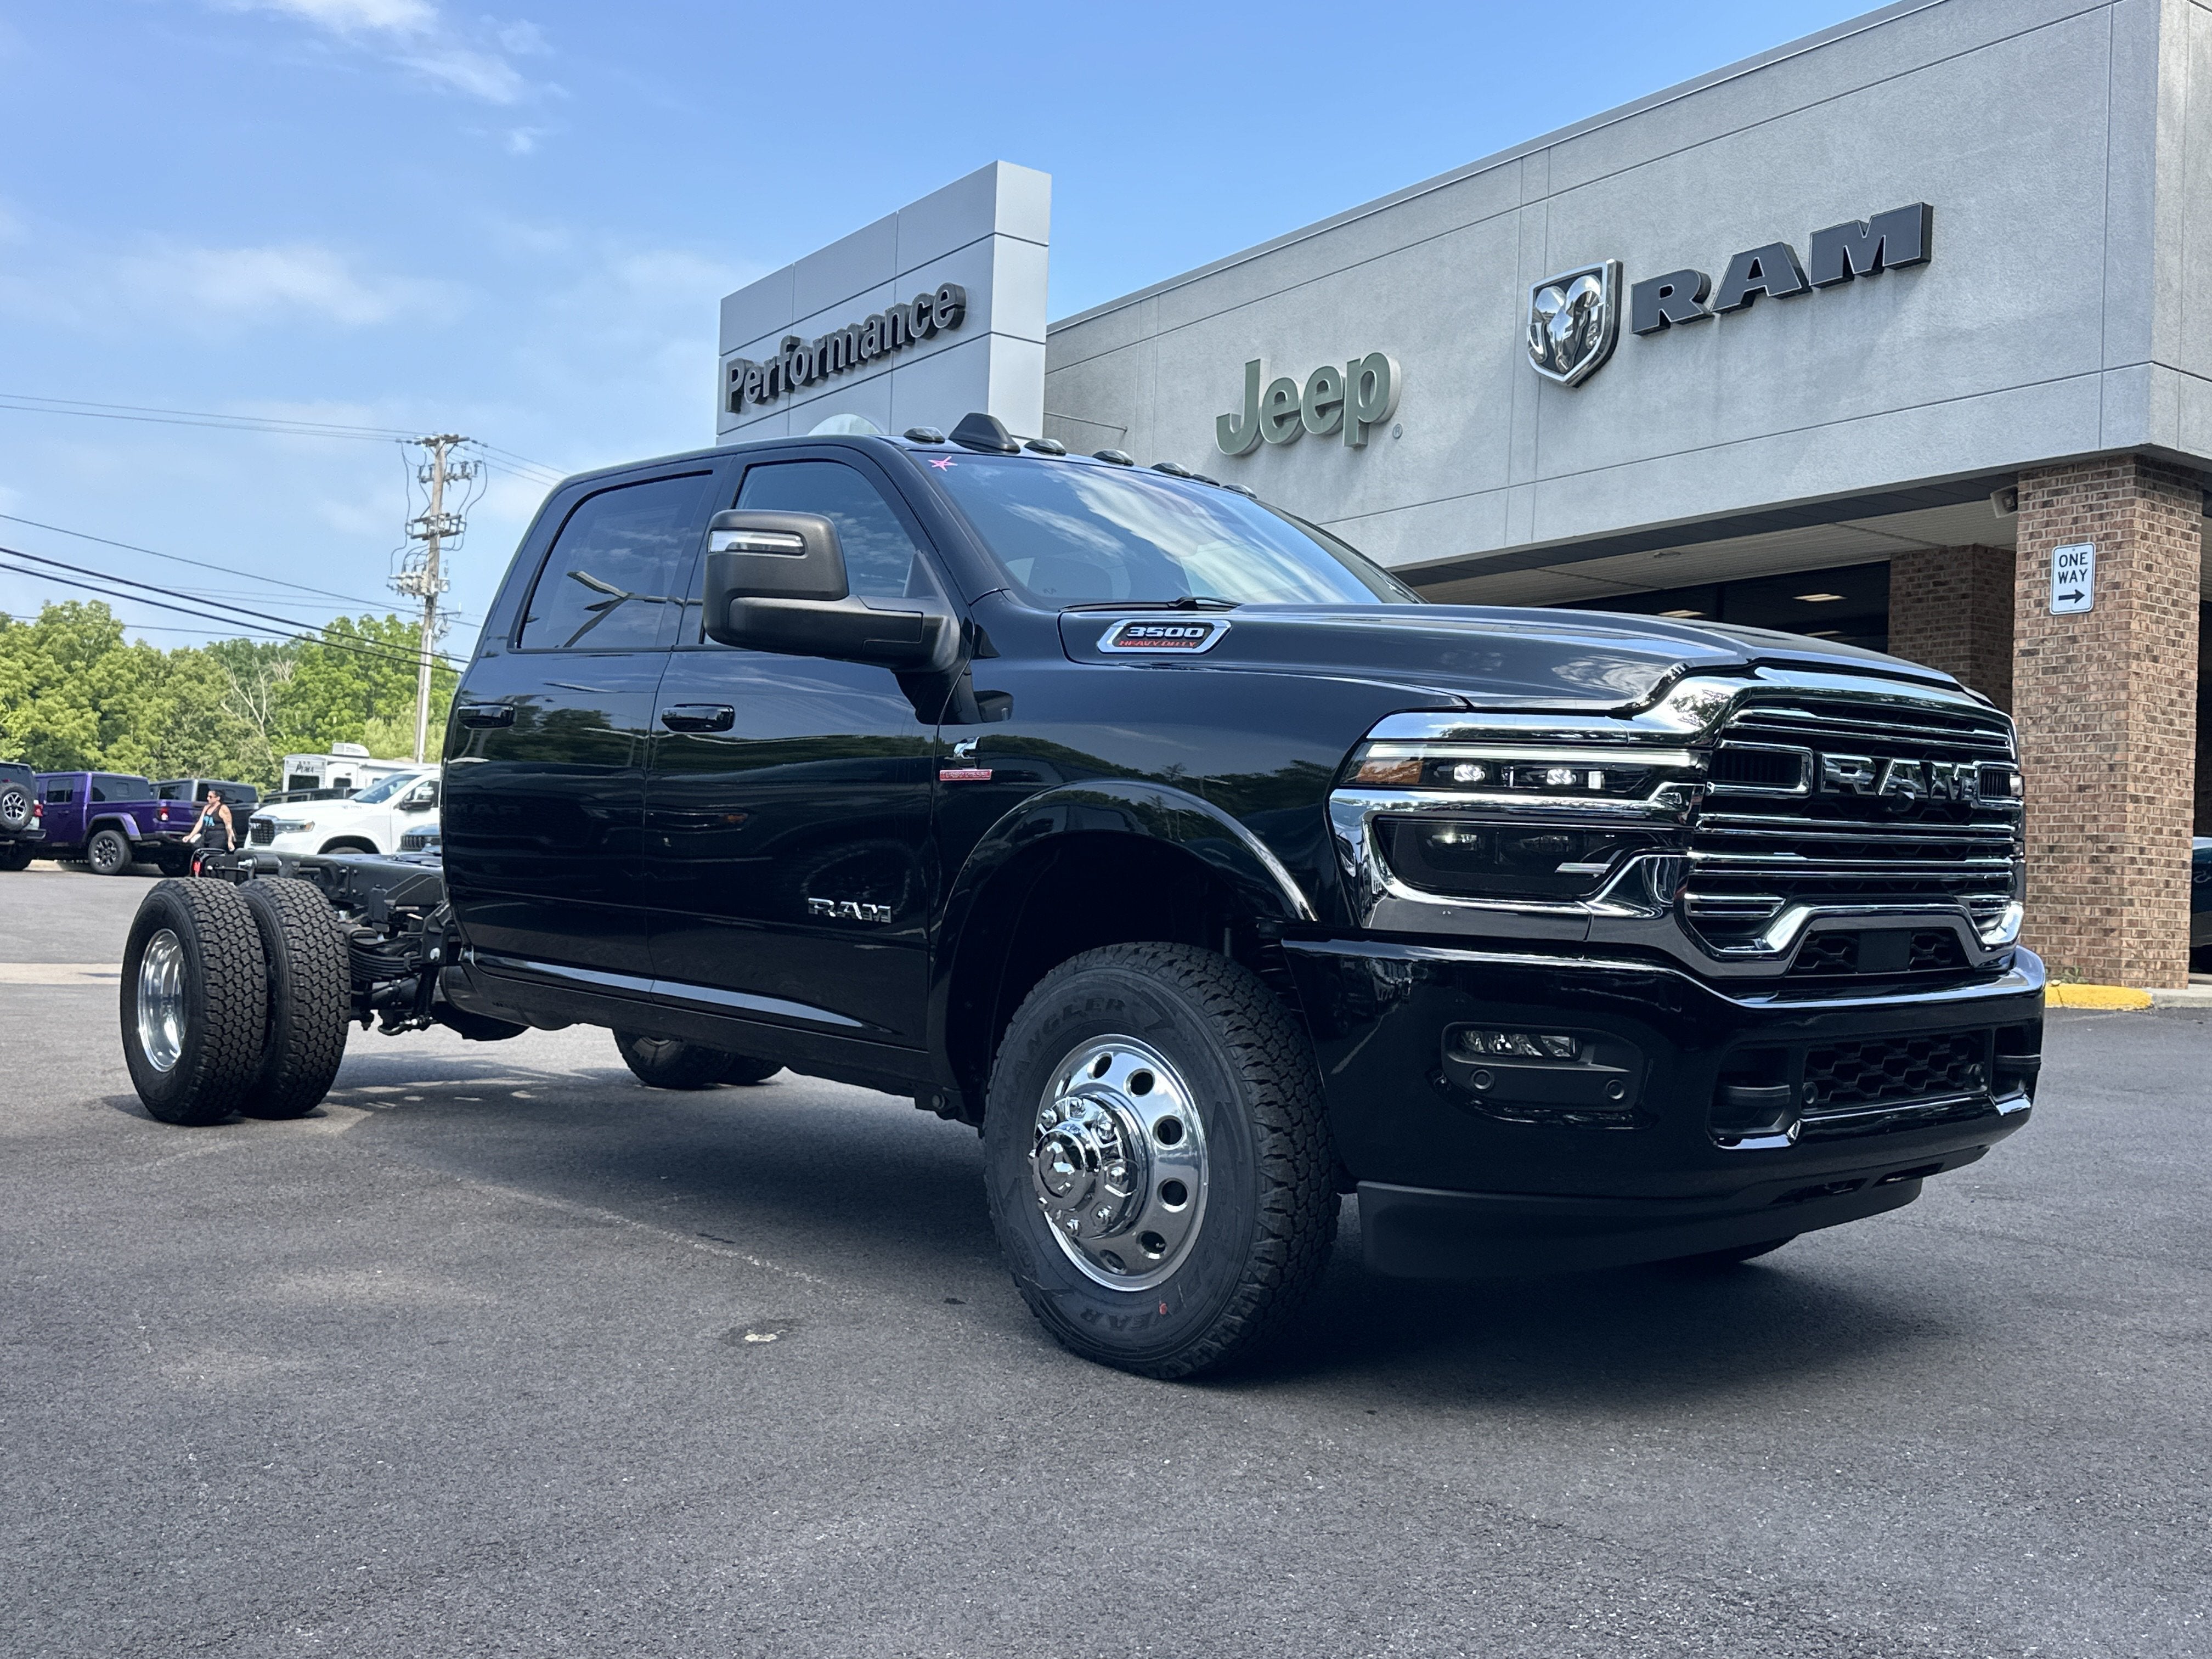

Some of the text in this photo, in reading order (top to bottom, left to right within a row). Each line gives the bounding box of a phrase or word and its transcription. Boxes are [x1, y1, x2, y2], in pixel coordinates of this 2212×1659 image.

[1630, 202, 1934, 336] RAM
[725, 282, 966, 413] Performance
[1216, 352, 1401, 455] Jeep
[2058, 551, 2089, 568] ONE
[2058, 568, 2088, 584] WAY
[1126, 627, 1205, 639] 3500
[1820, 753, 1977, 800] RAM
[808, 897, 892, 924] RAM
